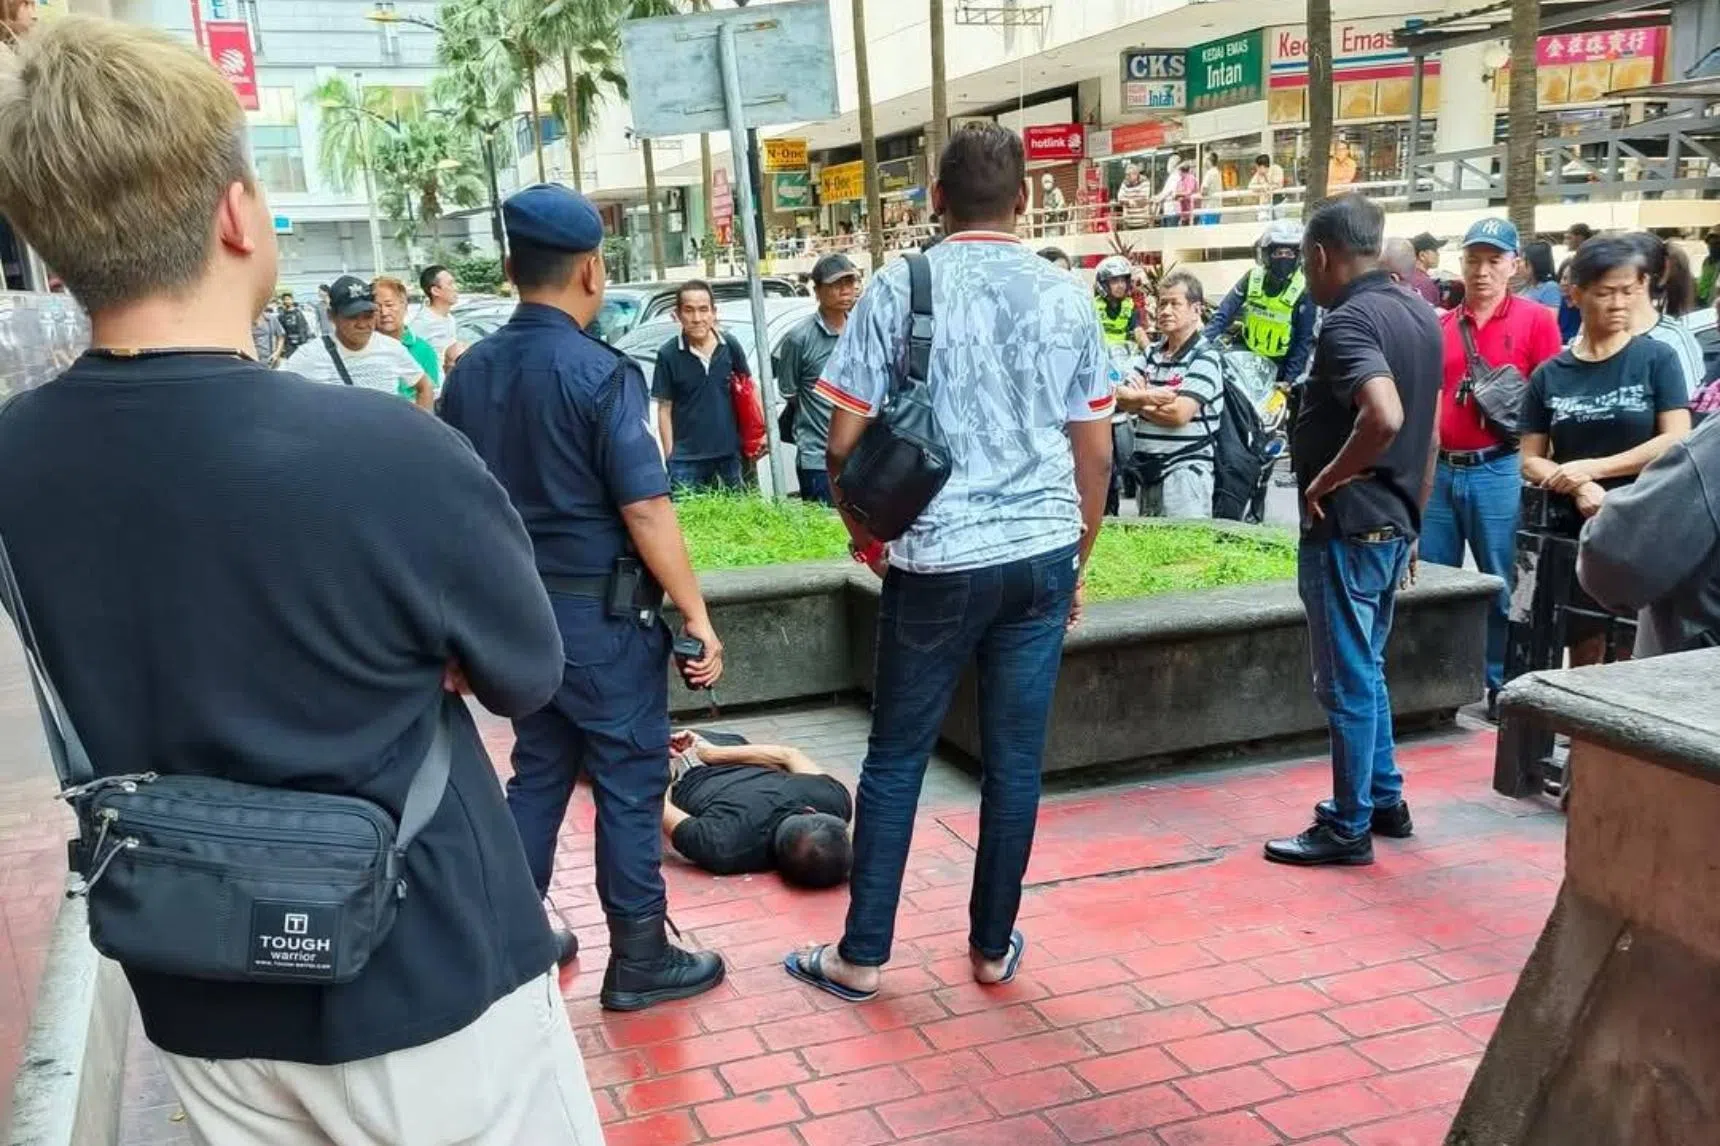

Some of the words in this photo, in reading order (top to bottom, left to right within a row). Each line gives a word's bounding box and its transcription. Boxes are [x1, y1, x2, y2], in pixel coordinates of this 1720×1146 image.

[1226, 39, 1249, 57] EMAS
[1130, 55, 1185, 78] CKS
[1206, 61, 1243, 90] Intan
[1031, 137, 1065, 149] hotlink
[259, 935, 331, 952] TOUGH
[270, 950, 317, 962] warrior
